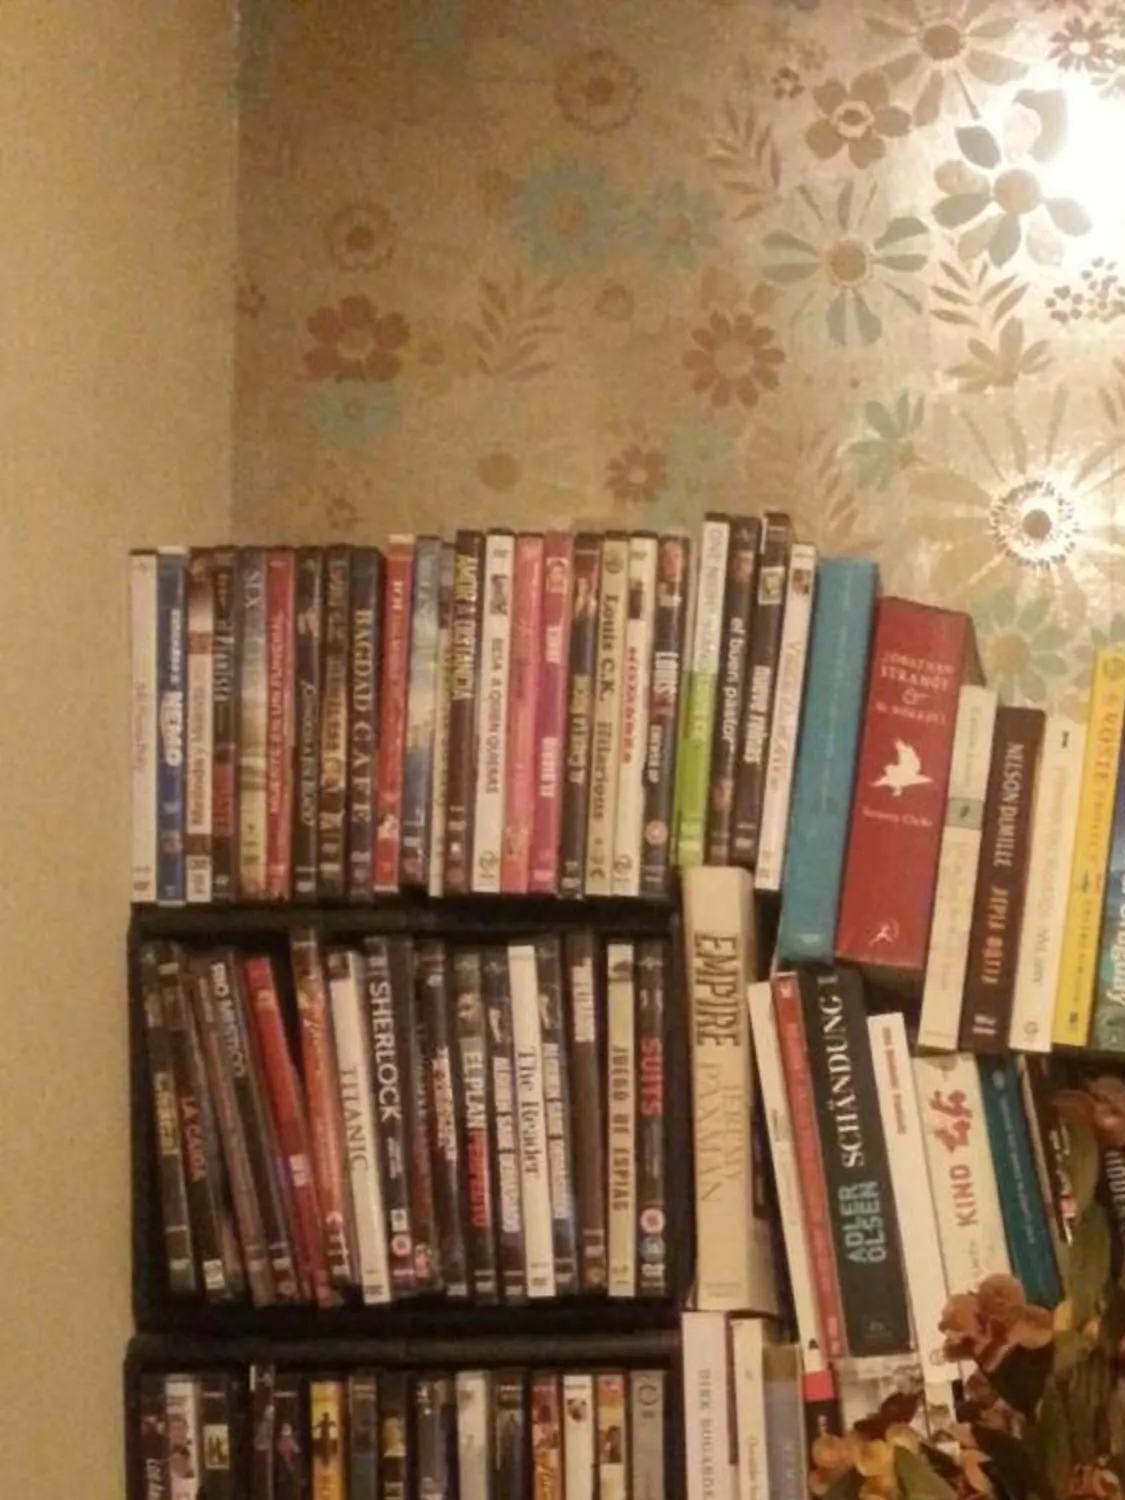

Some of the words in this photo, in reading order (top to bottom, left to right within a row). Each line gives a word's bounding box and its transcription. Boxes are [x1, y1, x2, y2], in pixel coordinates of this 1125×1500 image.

[454, 554, 478, 601] AMOR
[599, 594, 618, 651] Louis
[732, 618, 746, 635] el
[352, 610, 375, 711] BAGDAD
[452, 619, 477, 700] DISTANCIA
[599, 658, 615, 702] C.K.
[654, 652, 679, 694] LOUIS
[727, 639, 745, 681] buen
[747, 665, 770, 713] nueve
[162, 692, 182, 766] NEMO
[720, 687, 741, 741] pastor
[744, 716, 766, 763] reinas
[352, 721, 373, 824] CAFE
[592, 722, 613, 820] Hilarious
[998, 742, 1026, 802] NELSON
[695, 934, 742, 1047] EMPIRE
[368, 981, 402, 1123] SHERLOCK
[463, 1052, 483, 1076] EL
[516, 1048, 537, 1092] The
[612, 1045, 629, 1104] JUEGO
[640, 1036, 663, 1117] SUITS
[820, 995, 866, 1169] SCHÄNDUNG
[338, 1065, 369, 1174] TITANIC
[465, 1078, 486, 1129] PLAN
[613, 1113, 629, 1135] DE
[695, 1062, 723, 1202] PAXMAN
[721, 1084, 745, 1182] JEREMY
[519, 1100, 540, 1178] Reader
[838, 1184, 868, 1263] ADLER
[860, 1180, 887, 1263] OLSEN
[948, 1163, 978, 1228] KIND
